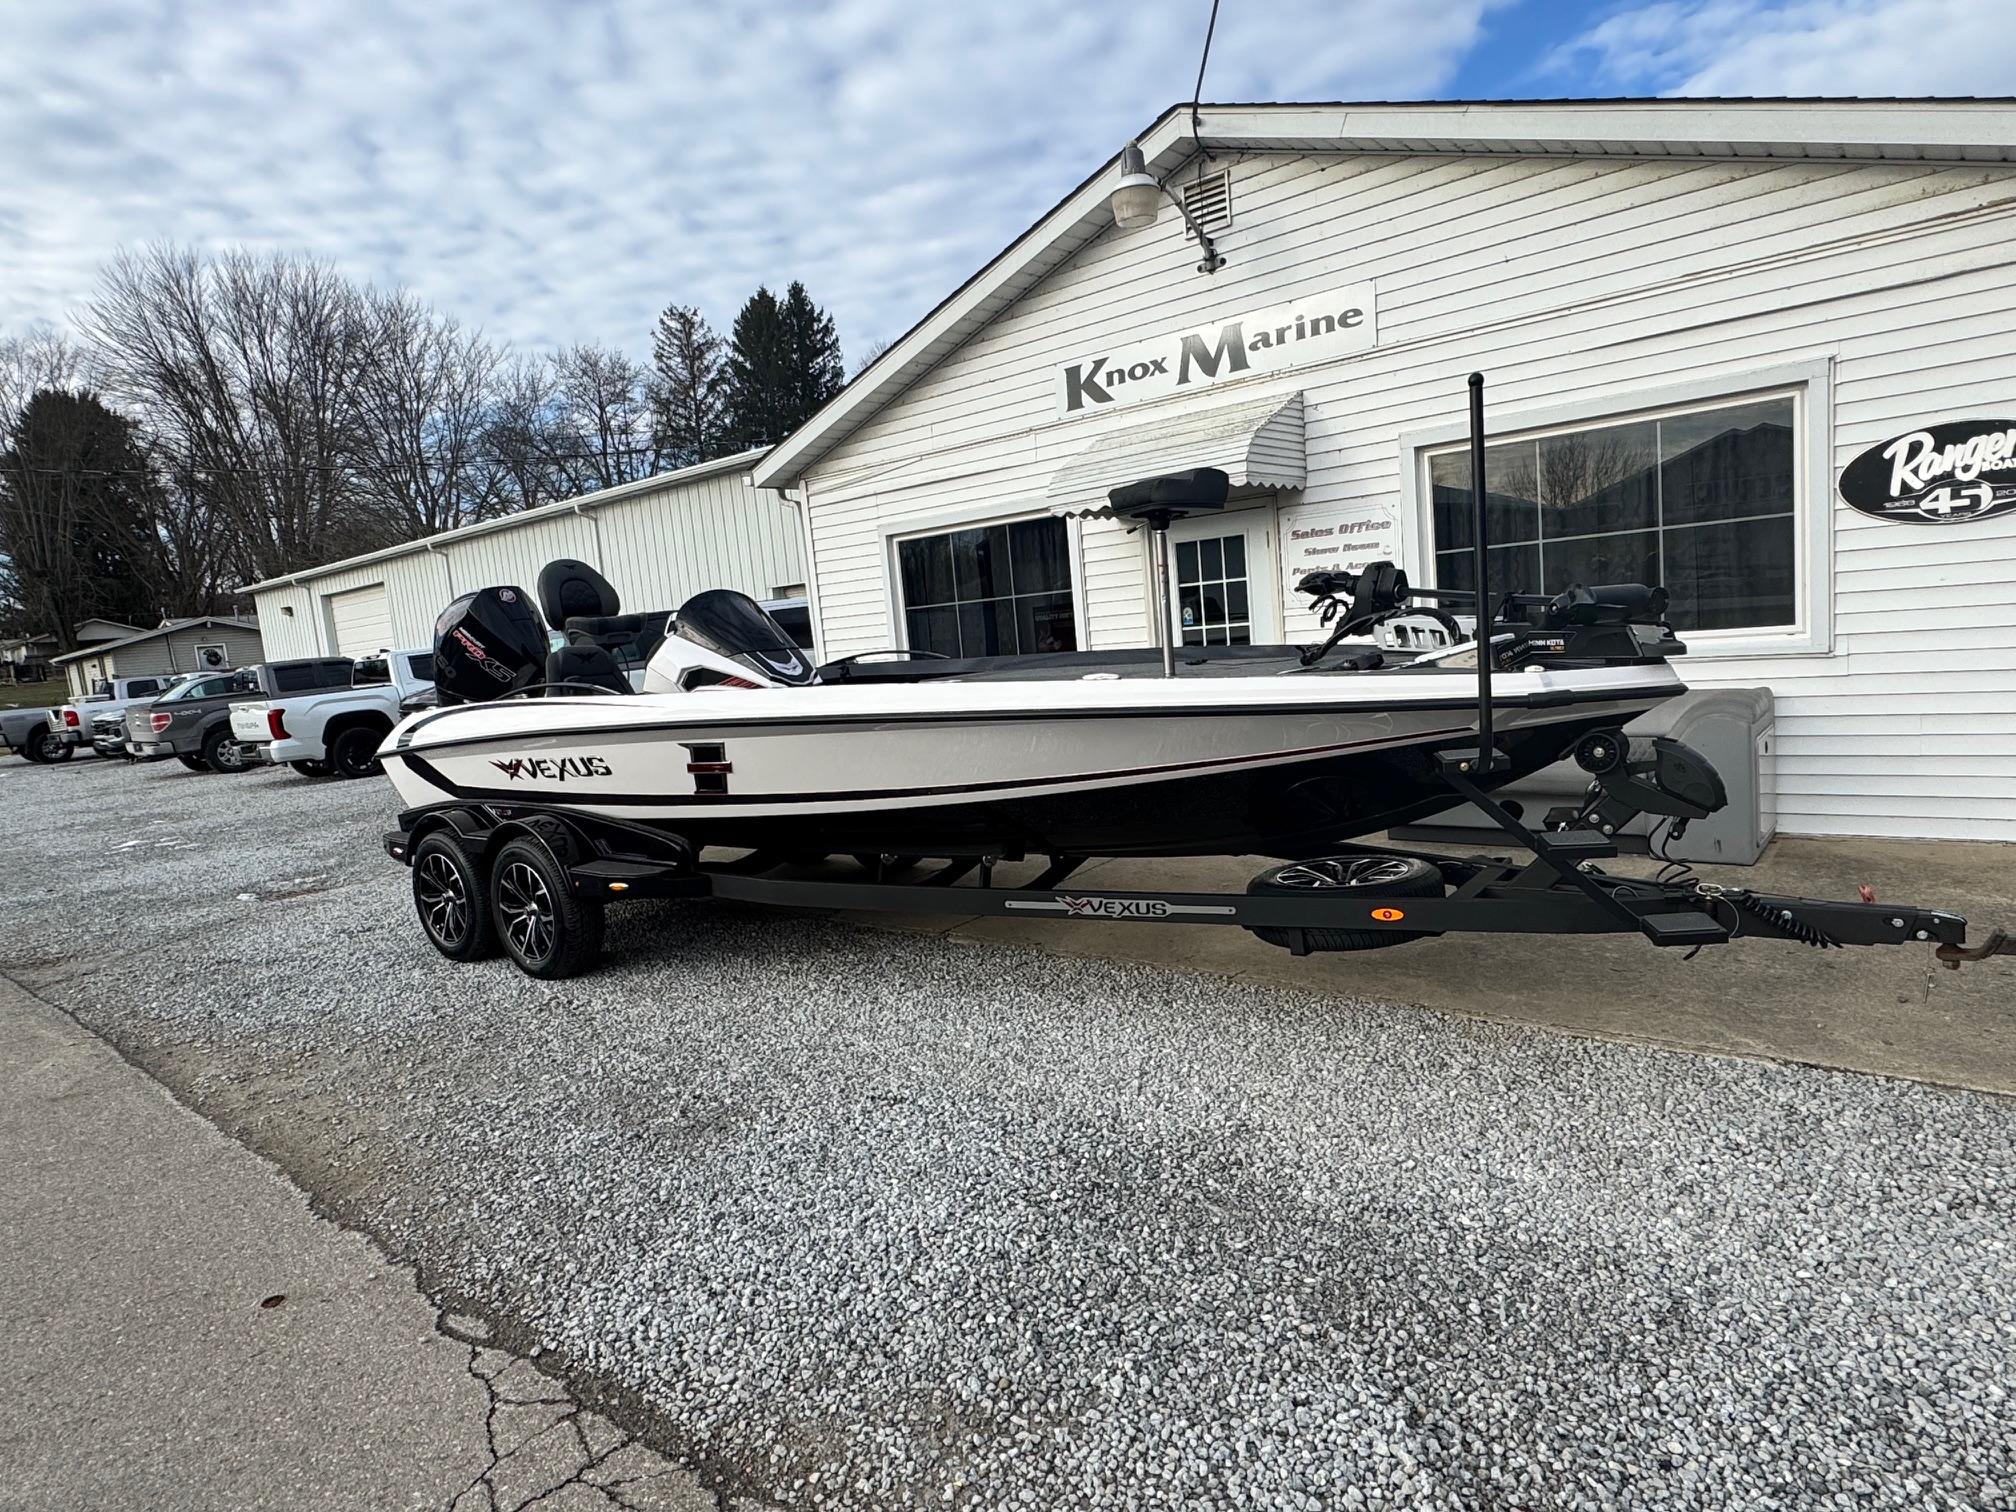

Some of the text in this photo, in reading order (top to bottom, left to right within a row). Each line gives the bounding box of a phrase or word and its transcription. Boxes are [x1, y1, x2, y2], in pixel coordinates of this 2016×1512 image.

[1064, 307, 1364, 413] Knox Marine
[1918, 483, 1994, 514] 45
[1940, 511, 1972, 519] YEARS
[1290, 519, 1392, 541] Sales Office
[1304, 541, 1380, 557] Show Room
[1528, 638, 1565, 647] MINN KOTA
[516, 755, 612, 782] VEXUS
[1087, 898, 1168, 917] VEXUS
